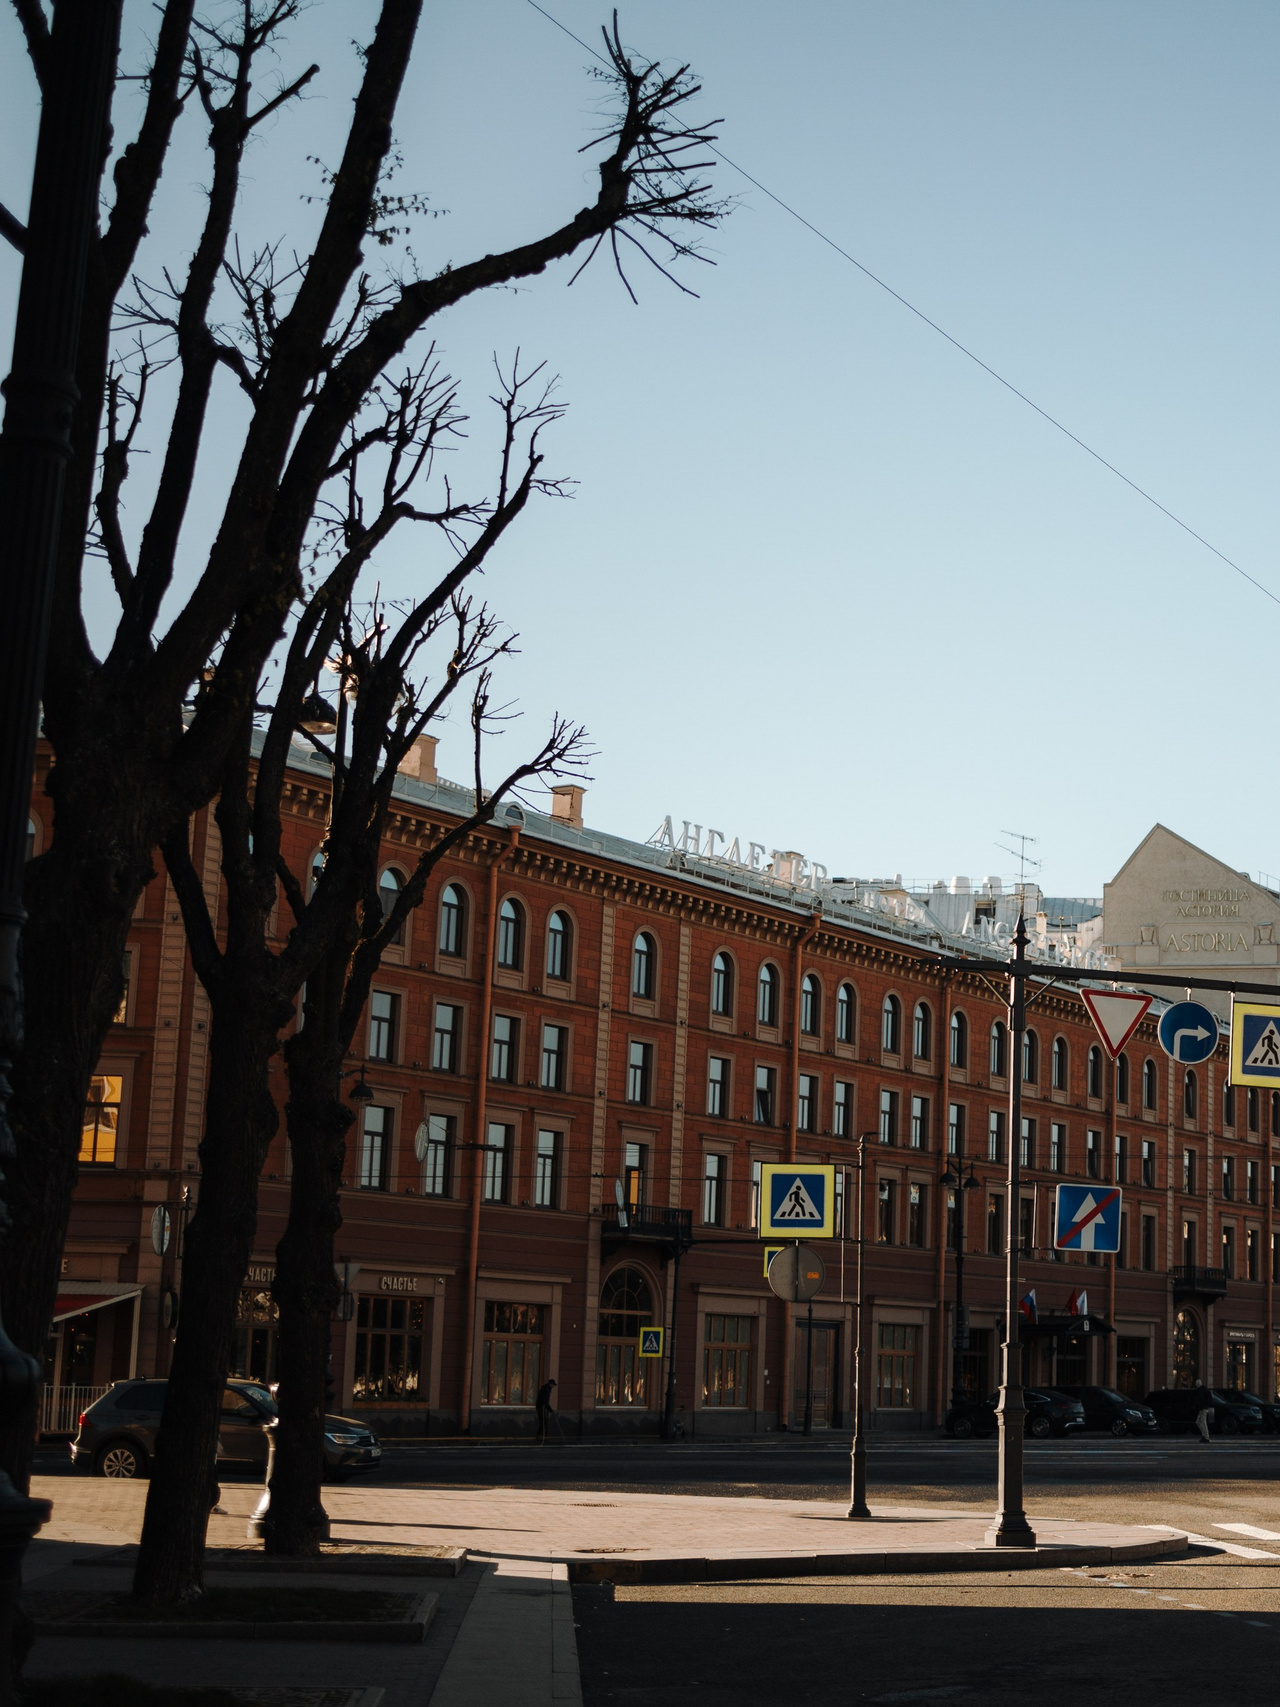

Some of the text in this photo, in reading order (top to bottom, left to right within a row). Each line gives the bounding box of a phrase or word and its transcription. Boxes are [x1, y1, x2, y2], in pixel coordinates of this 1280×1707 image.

[655, 814, 828, 891] АНГЛЕТЕР
[1162, 889, 1251, 902] ГОСТИНИЦА
[1175, 904, 1241, 917] АСТОРИЯ
[863, 890, 1113, 971] HOTEL ANGETERRE
[1163, 932, 1250, 952] ASTORIA
[381, 1276, 418, 1291] СЧАСТЬЕ
